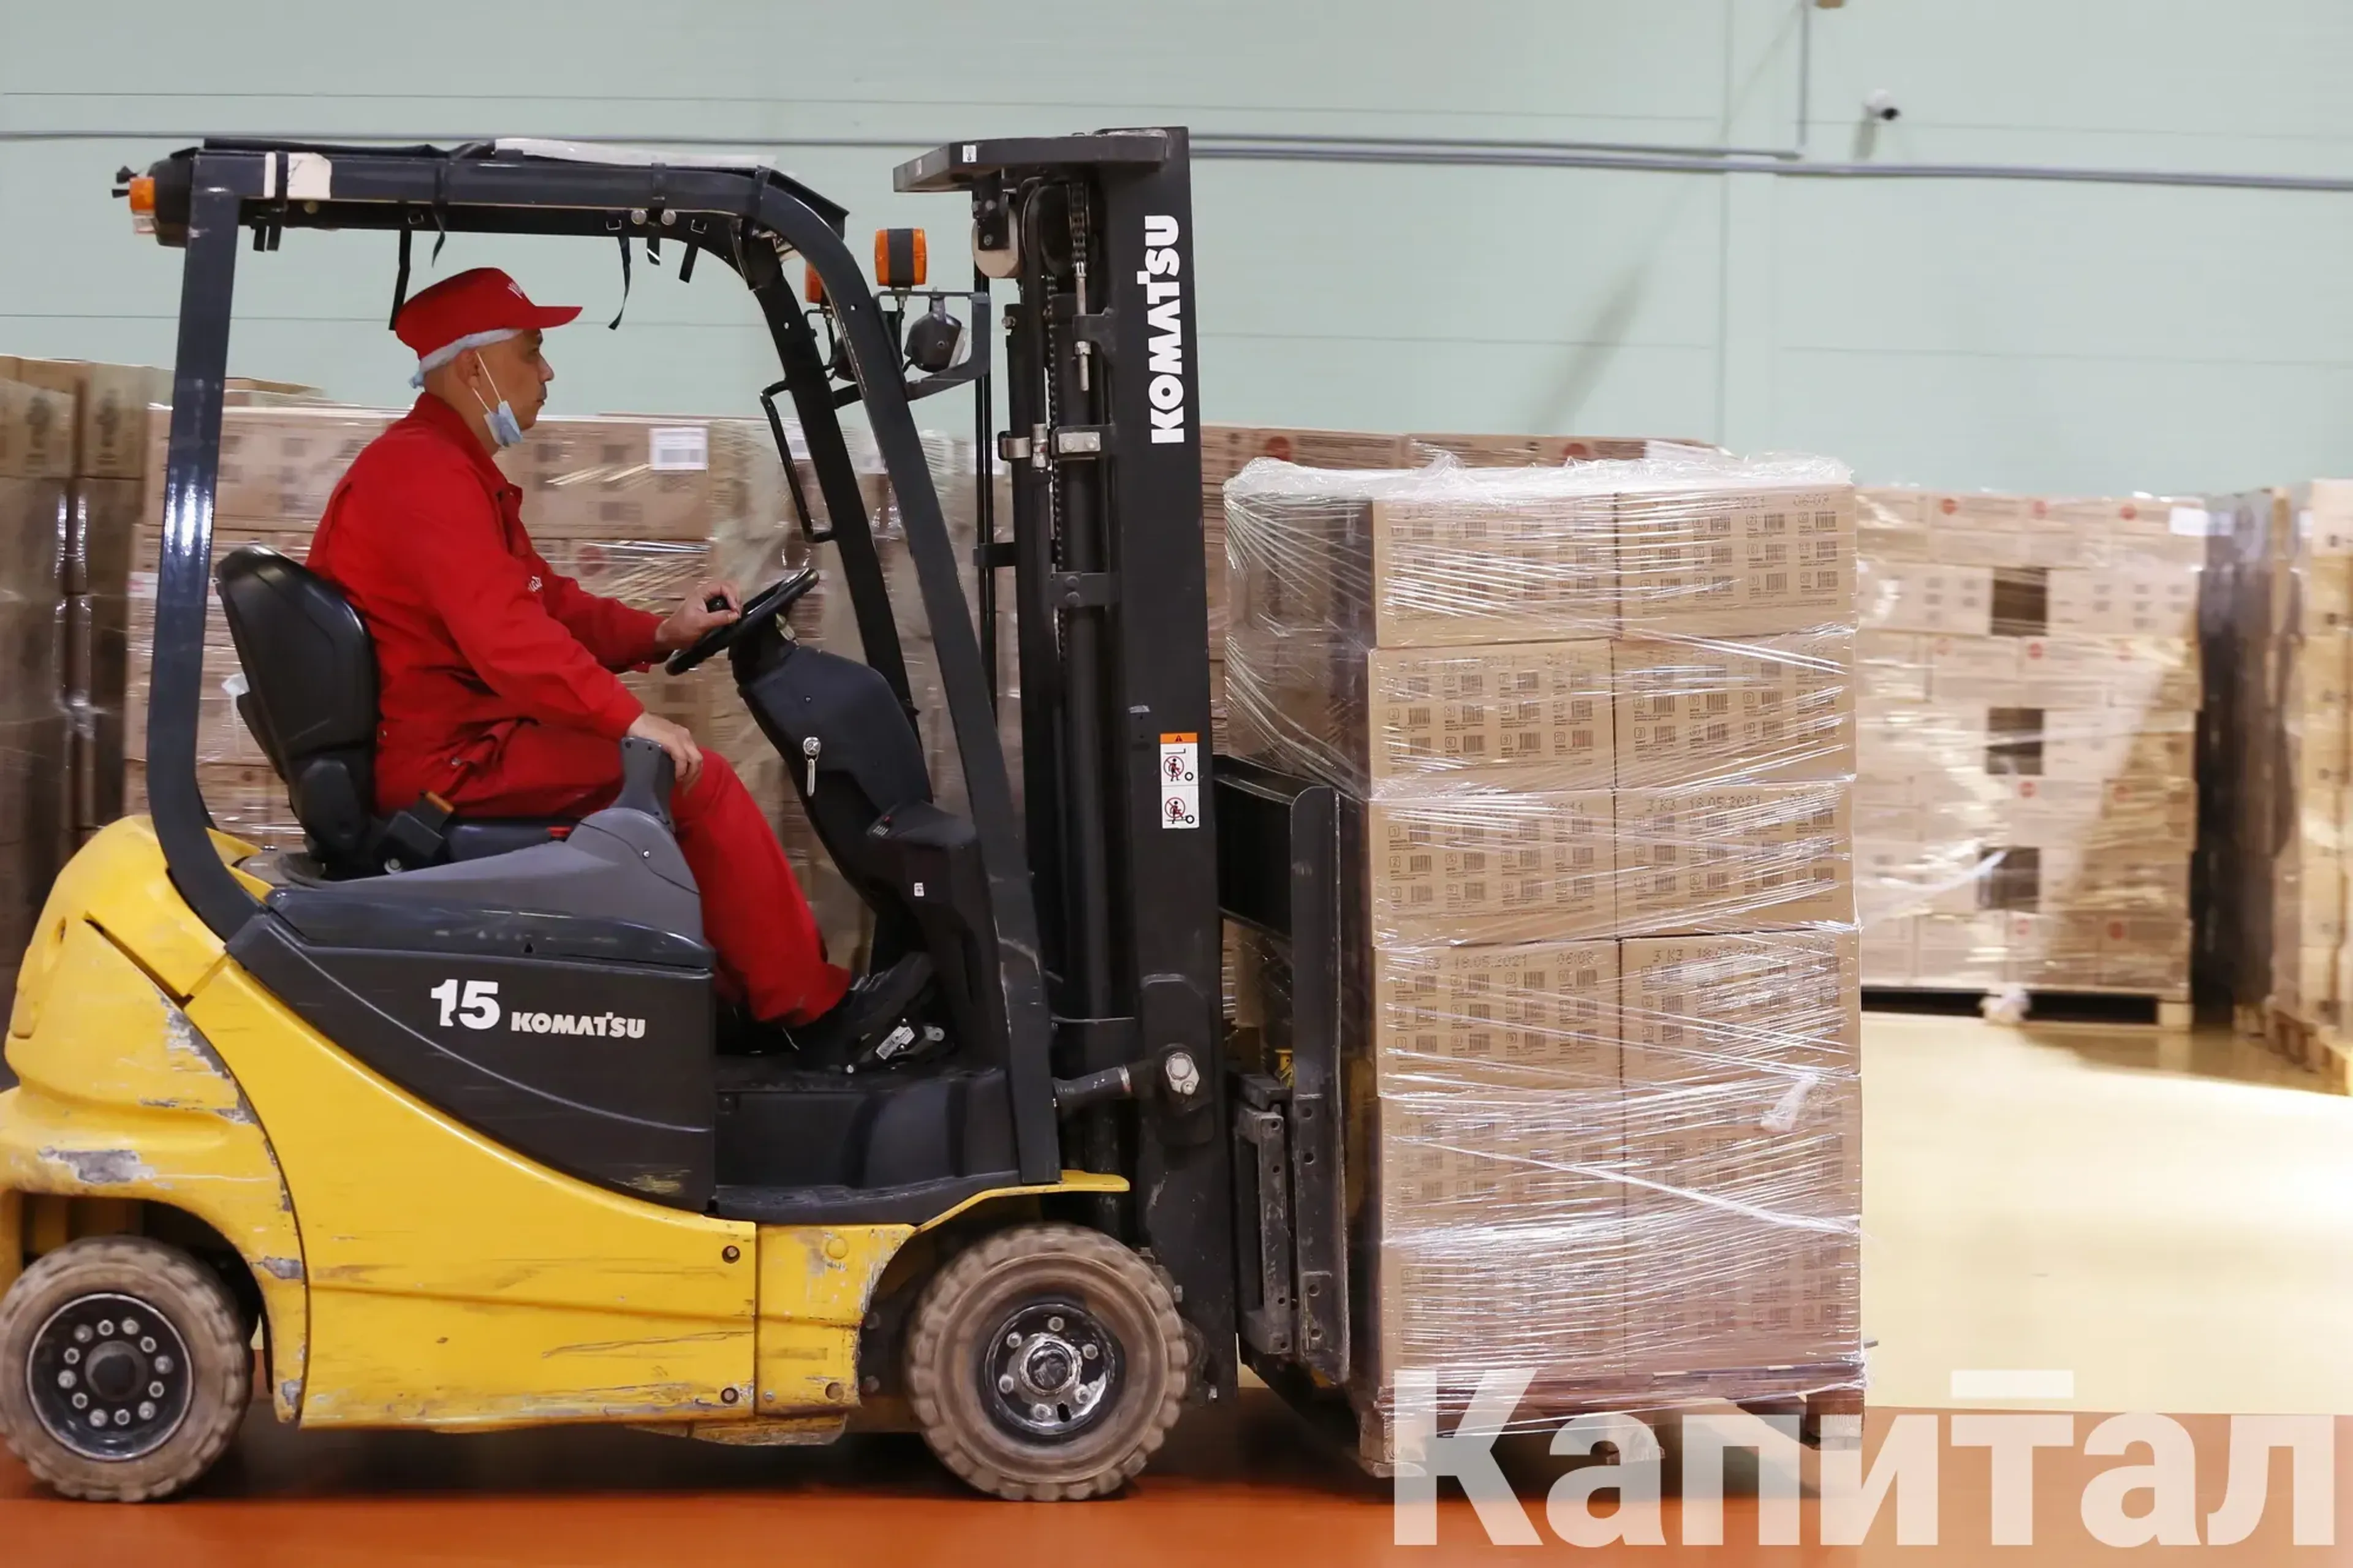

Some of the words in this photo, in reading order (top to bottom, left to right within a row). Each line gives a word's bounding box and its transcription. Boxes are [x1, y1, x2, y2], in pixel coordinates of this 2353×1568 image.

[1137, 214, 1184, 444] KOMATSU
[431, 979, 501, 1030] 15
[511, 1011, 646, 1039] KOMATSU
